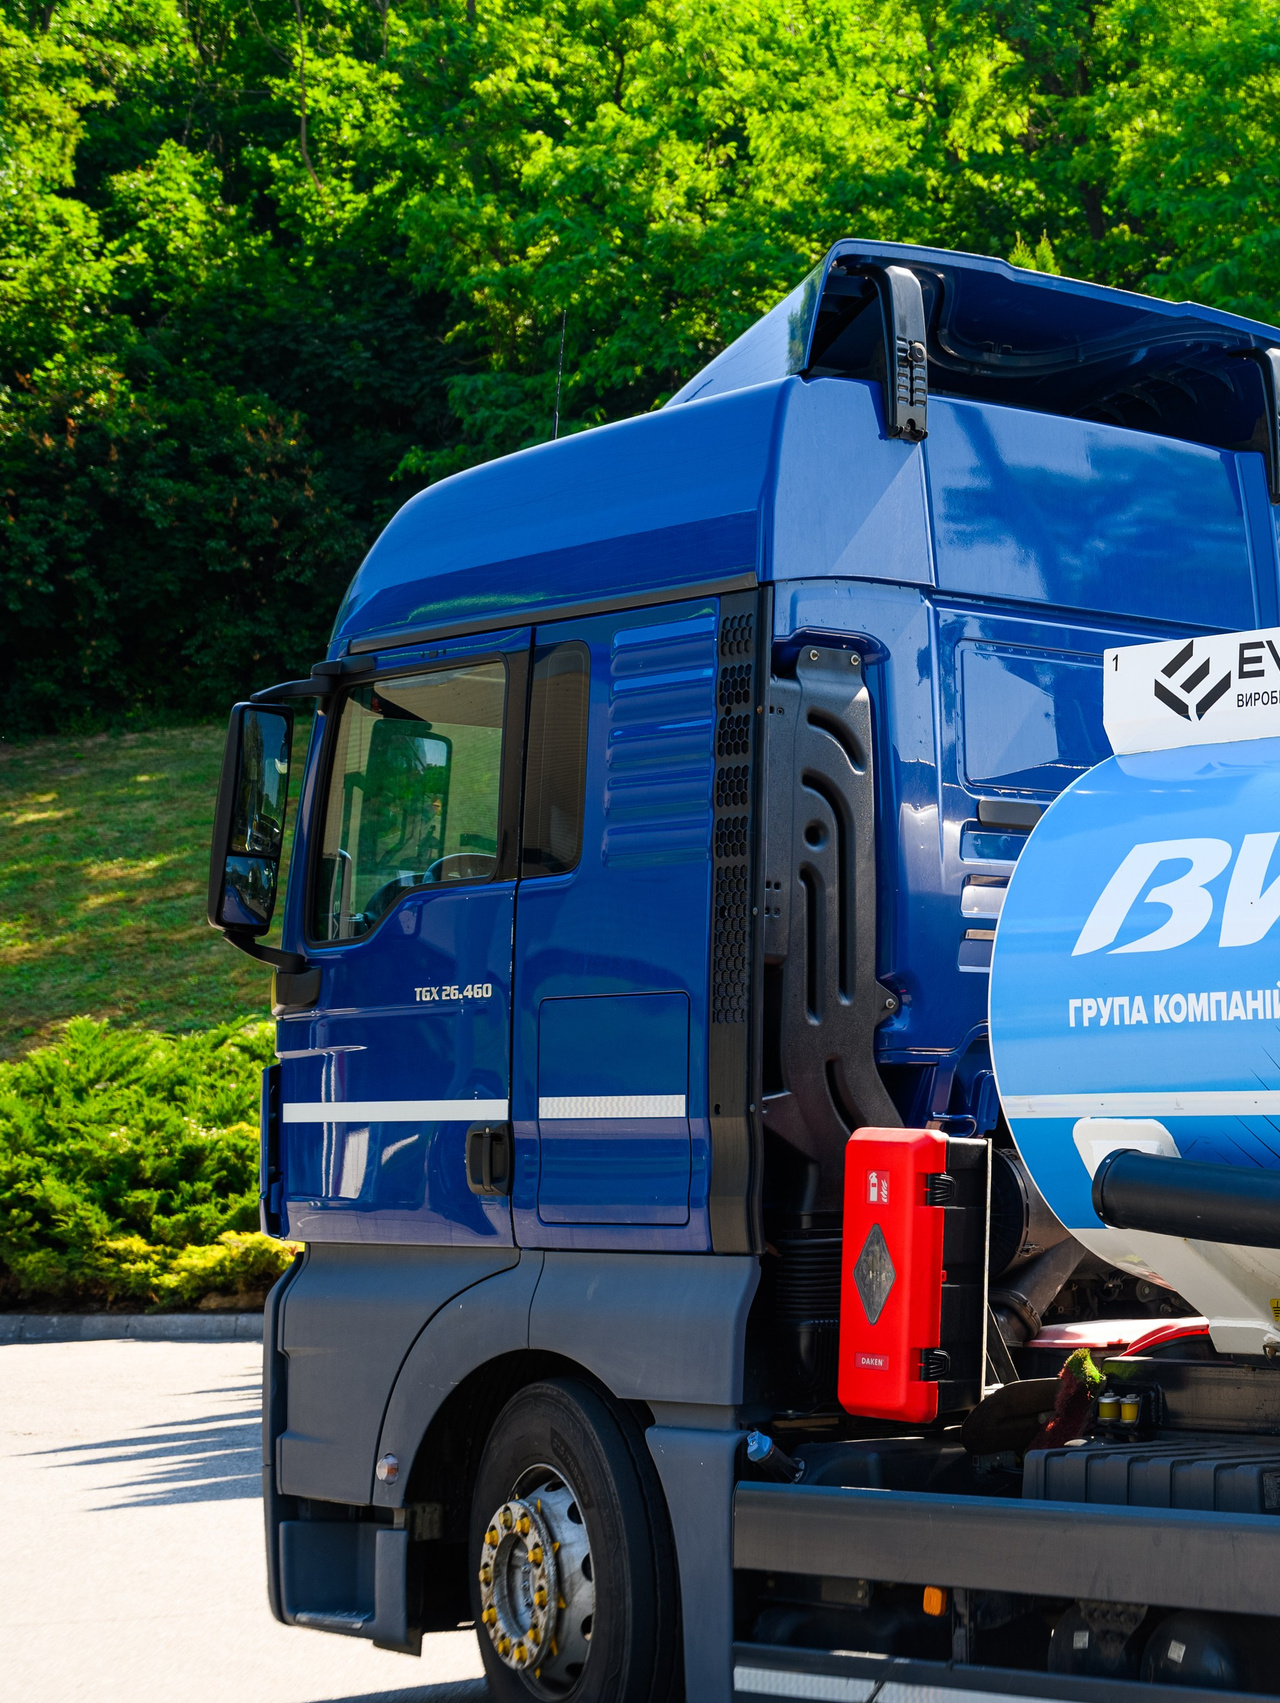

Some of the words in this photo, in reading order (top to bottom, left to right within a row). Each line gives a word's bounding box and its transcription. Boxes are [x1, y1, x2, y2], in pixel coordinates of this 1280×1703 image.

[1112, 654, 1119, 672] 1
[414, 986, 440, 1002] TGX
[441, 983, 492, 1000] 26.460
[1068, 995, 1149, 1028] ГРУПА
[861, 1357, 883, 1366] DAKEN
